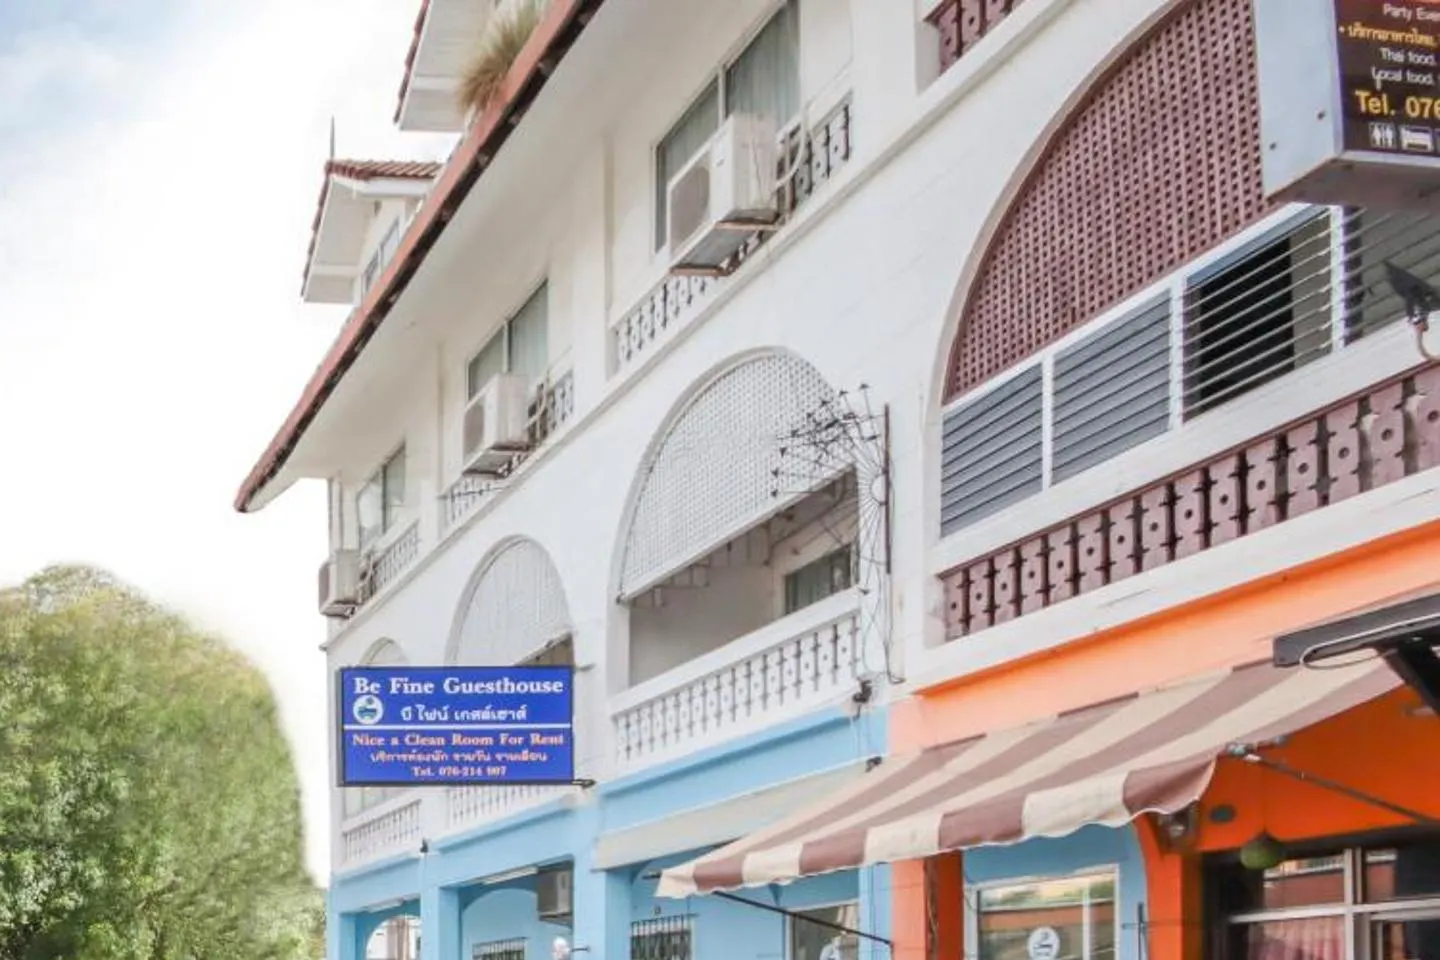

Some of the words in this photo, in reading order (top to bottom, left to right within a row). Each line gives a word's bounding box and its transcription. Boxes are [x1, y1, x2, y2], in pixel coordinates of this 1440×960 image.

[1383, 3, 1412, 23] Party
[1380, 47, 1405, 63] Thai
[1355, 90, 1396, 116] Tel.
[353, 677, 380, 694] Be
[389, 677, 435, 694] Fine
[443, 677, 564, 694] Guesthouse
[352, 733, 385, 746] Nice
[404, 733, 446, 746] Clean
[452, 733, 494, 746] Room
[500, 733, 525, 746] For
[530, 733, 564, 746] Rent
